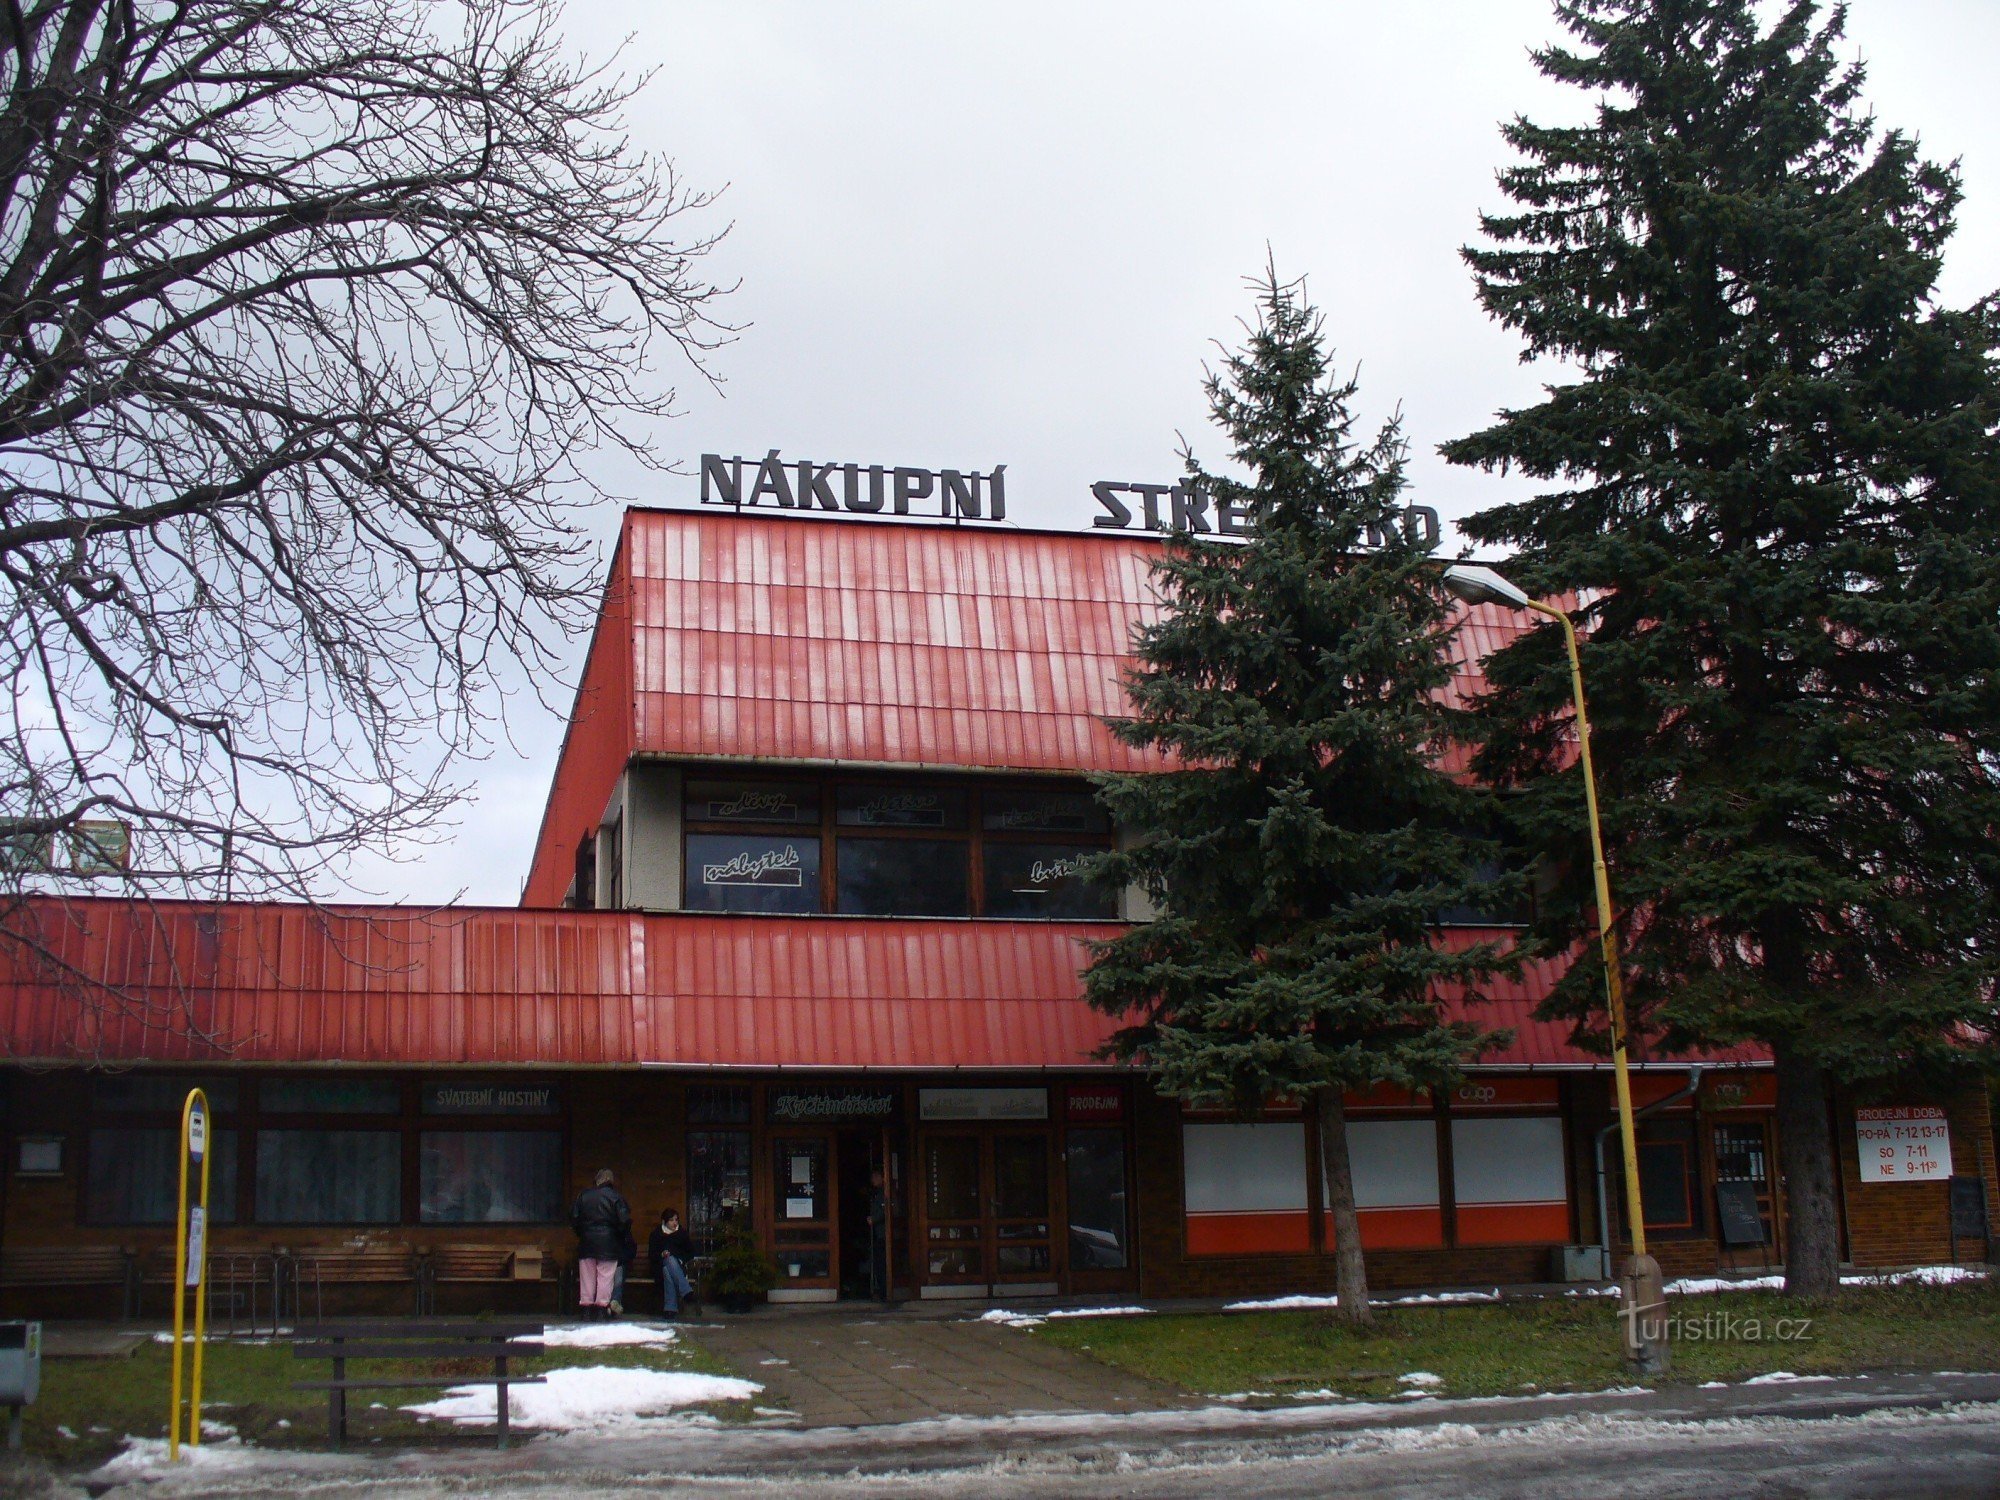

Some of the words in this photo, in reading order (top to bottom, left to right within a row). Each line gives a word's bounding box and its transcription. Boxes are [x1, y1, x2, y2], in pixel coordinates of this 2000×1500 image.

[700, 449, 1008, 521] NÁKUPNÍ
[1091, 477, 1440, 548] STŘEKO
[707, 844, 800, 881] nábytek
[498, 1089, 550, 1106] HOSTINY
[1069, 1096, 1118, 1110] PRODEJNA
[1857, 1107, 1909, 1119] PRODEJNÍ
[1914, 1108, 1943, 1119] DOBA
[1858, 1127, 1891, 1140] PO-PÁ
[1894, 1126, 1918, 1139] 7-12
[1920, 1126, 1946, 1138] 13-17
[1880, 1147, 1894, 1158] SO
[1906, 1145, 1928, 1157] 7-11
[1880, 1164, 1894, 1175] NE
